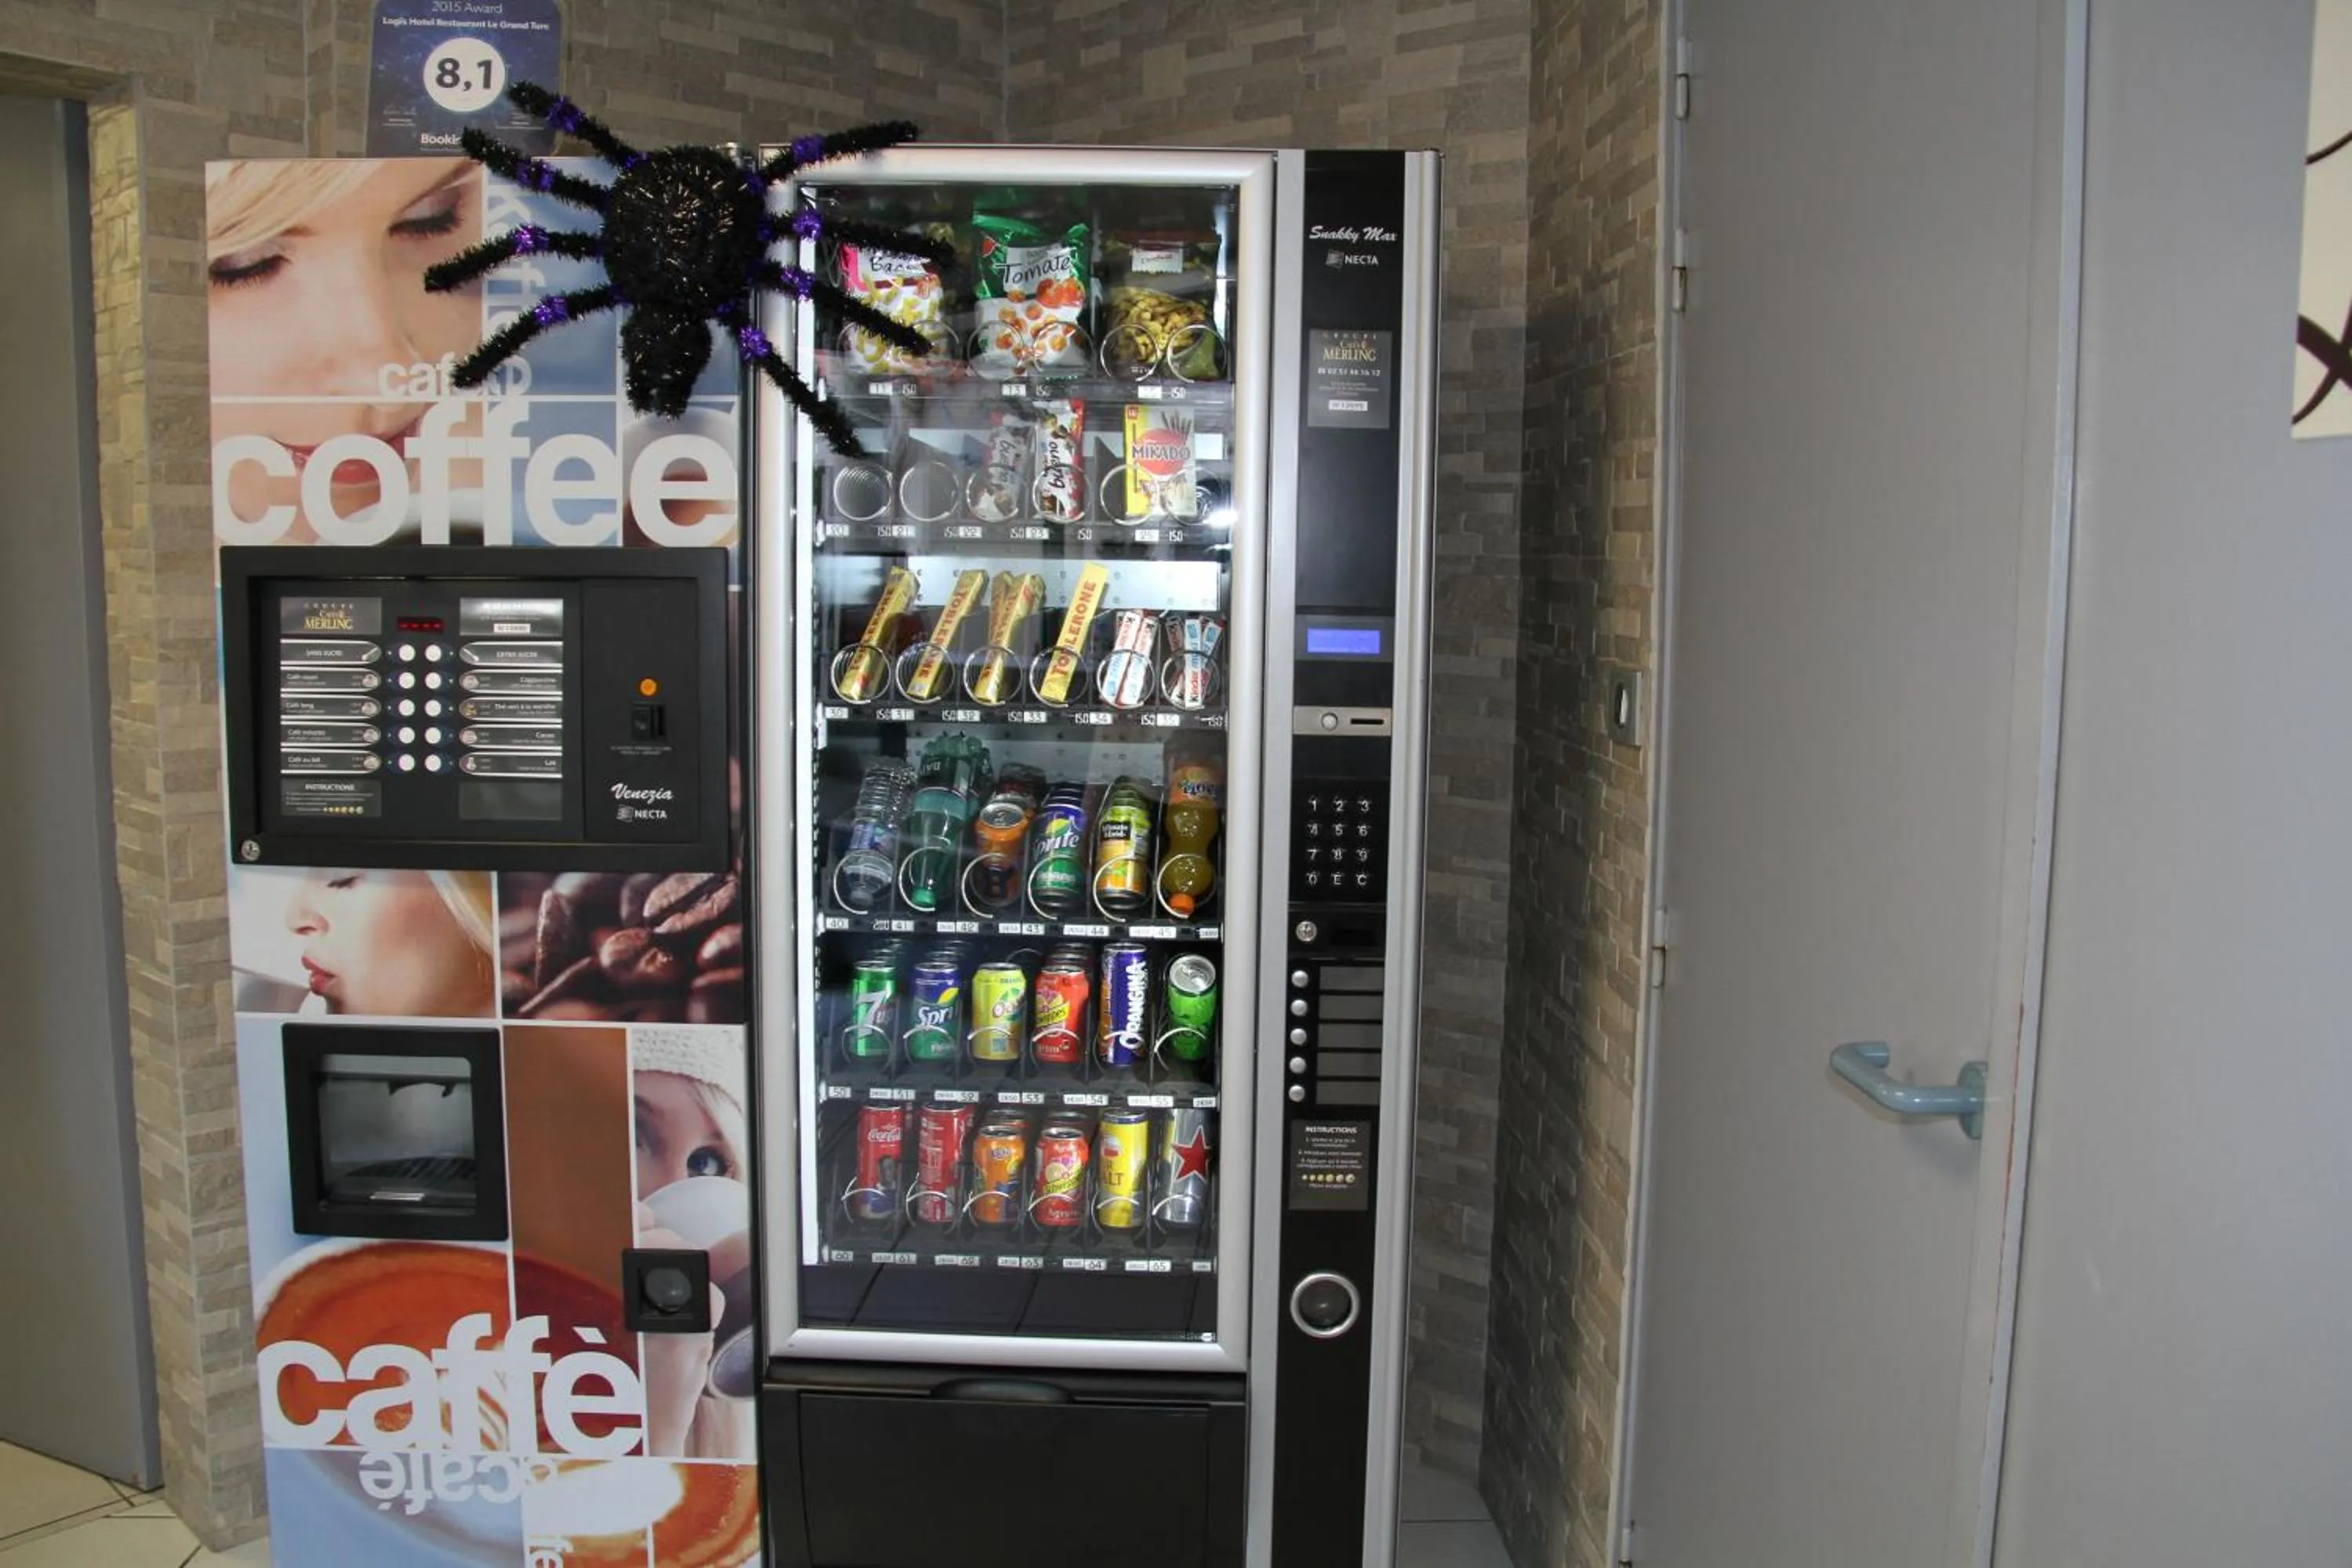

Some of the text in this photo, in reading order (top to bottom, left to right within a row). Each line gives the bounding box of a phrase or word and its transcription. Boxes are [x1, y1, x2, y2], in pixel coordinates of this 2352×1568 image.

[431, 1, 503, 13] 2015 Award
[382, 16, 407, 26] Logis
[408, 17, 434, 26] Hotel
[436, 18, 486, 28] Restaurant
[434, 57, 492, 92] 8,1
[1000, 253, 1072, 284] Tomate
[1345, 255, 1379, 265] NECTA
[378, 350, 456, 397] caf
[1131, 445, 1191, 460] MIKADO
[212, 400, 739, 547] coffee
[1048, 441, 1065, 489] bueno
[610, 782, 673, 804] Venezia
[634, 810, 667, 819] NECTA
[1335, 800, 1344, 812] 2
[1361, 800, 1370, 812] 3
[1335, 823, 1343, 837] 5
[1359, 825, 1368, 837] 6
[256, 1313, 644, 1456] caffè
[358, 1450, 522, 1515] café
